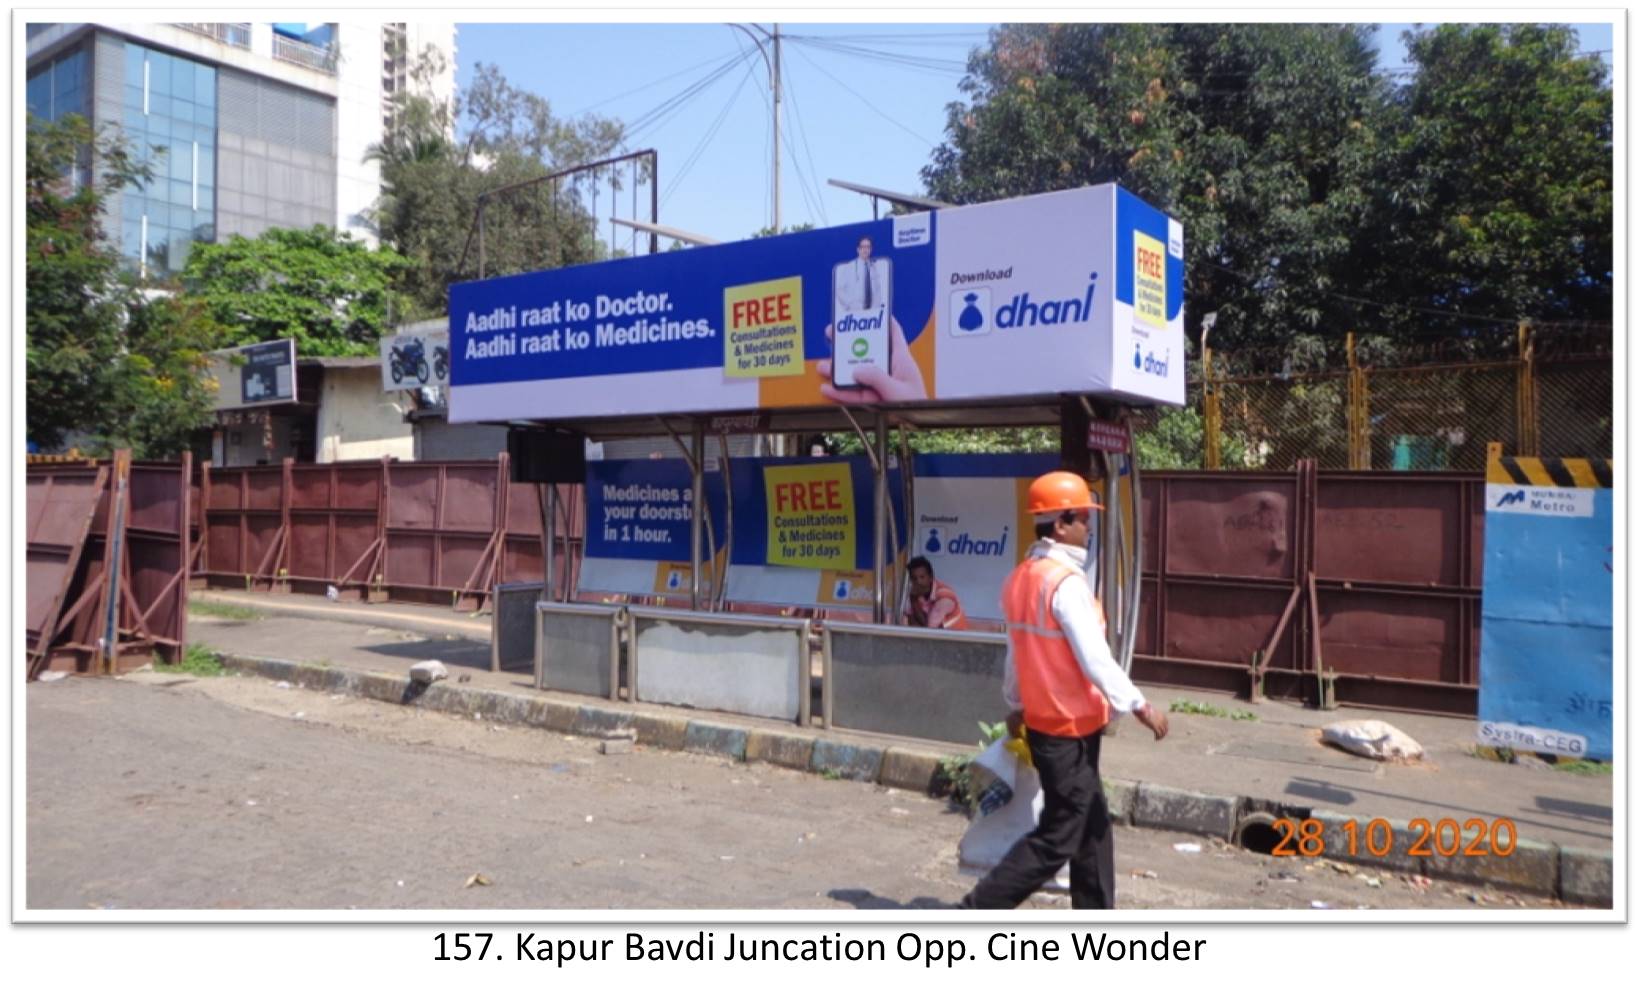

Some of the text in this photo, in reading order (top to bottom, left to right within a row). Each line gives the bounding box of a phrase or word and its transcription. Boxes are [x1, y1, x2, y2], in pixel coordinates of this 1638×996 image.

[1136, 246, 1162, 280] FREE
[950, 266, 1013, 285] Download
[995, 271, 1098, 329] dhani
[465, 291, 673, 333] Aadhi raat ko Doctor.
[732, 293, 792, 328] FREE
[837, 304, 885, 333] dhani
[465, 317, 716, 360] Aadhi raat ko Medicines.
[730, 324, 797, 343] Consultations
[734, 339, 795, 356] & Medicines
[738, 353, 791, 369] for 30 days
[603, 484, 693, 502] Medicines a
[775, 480, 842, 513] FREE
[604, 503, 693, 523] your doorst
[1530, 499, 1575, 513] Metro
[774, 513, 849, 528] Consultations
[920, 514, 960, 525] Download
[604, 523, 672, 543] in 1 hour.
[778, 528, 845, 543] & Medicines
[949, 526, 1010, 556] dhani
[782, 542, 840, 559] for 30 days
